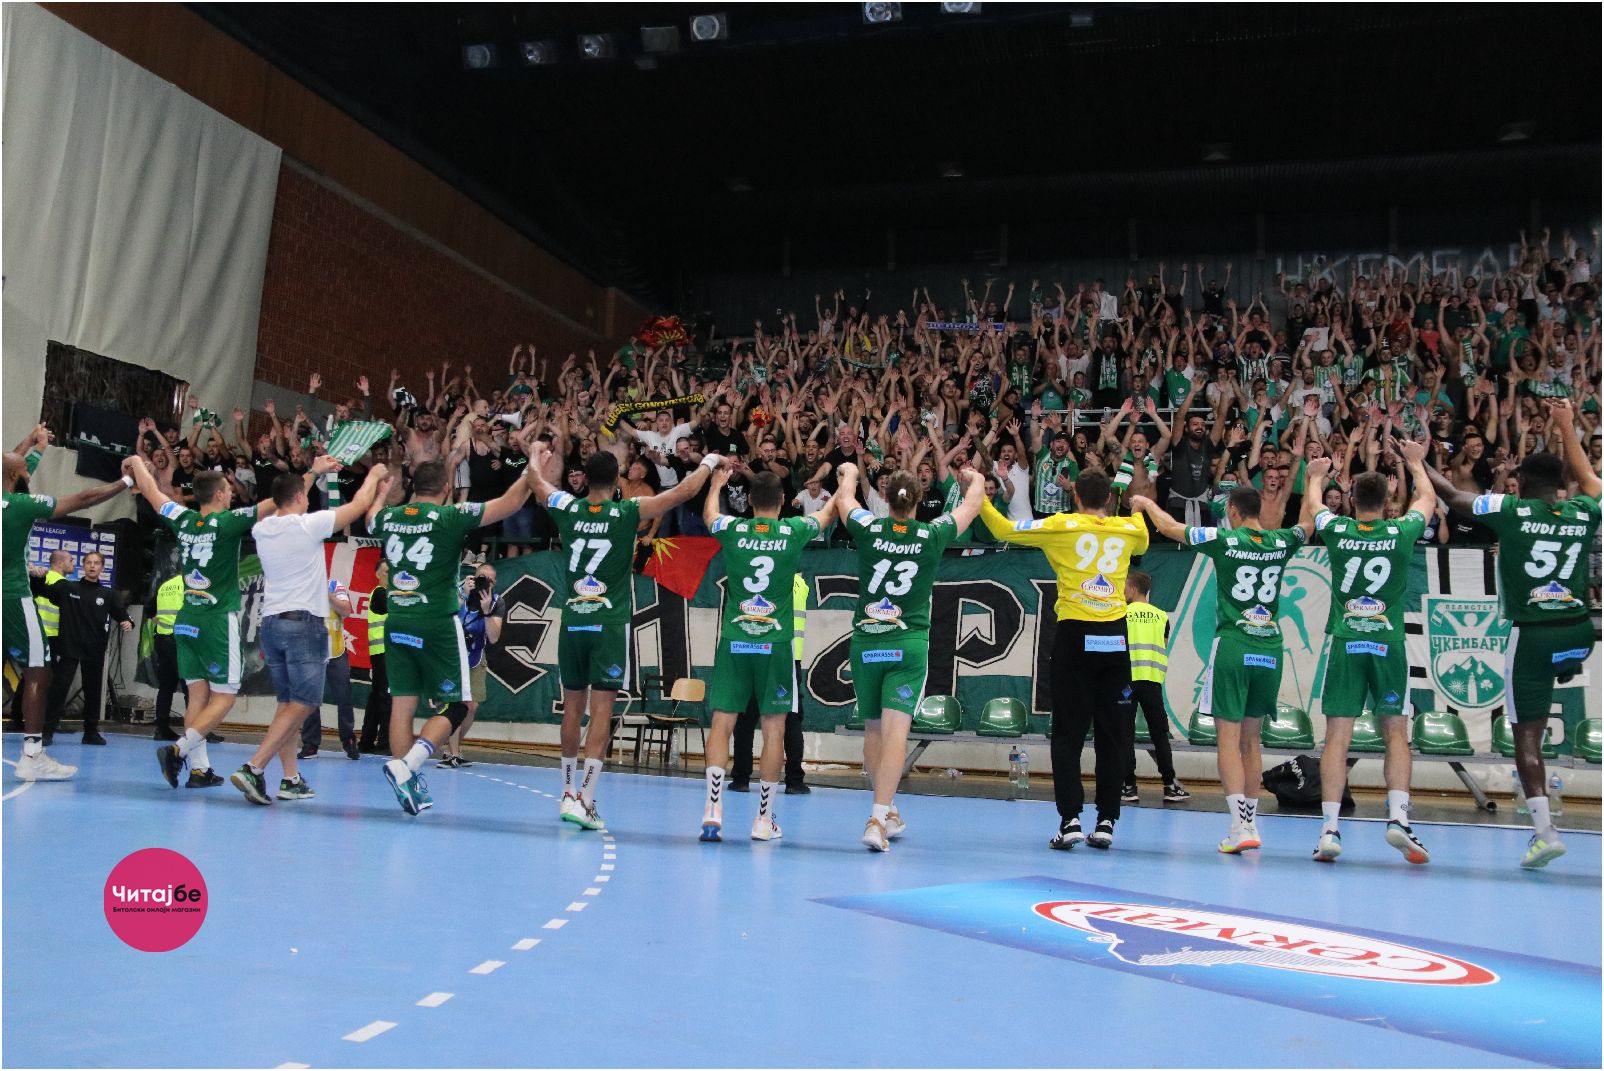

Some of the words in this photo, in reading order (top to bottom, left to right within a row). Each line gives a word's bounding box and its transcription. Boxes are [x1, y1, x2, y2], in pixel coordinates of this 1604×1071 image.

[45, 527, 67, 535] LEAGUE
[574, 520, 609, 534] HOSNI
[1520, 521, 1556, 535] RUDI
[385, 534, 435, 570] 44
[570, 538, 612, 574] 17
[737, 537, 787, 551] OJLESKI
[872, 538, 922, 555] RADOVIC
[1075, 532, 1126, 574] 98
[1337, 538, 1396, 551] KOSTESKI
[1524, 540, 1583, 580] 51
[742, 555, 775, 593] 3
[867, 558, 919, 596] 13
[1231, 565, 1282, 604] 88
[1340, 556, 1392, 595] 19
[1126, 611, 1160, 621] GARDA
[864, 651, 895, 659] SPARKASSE
